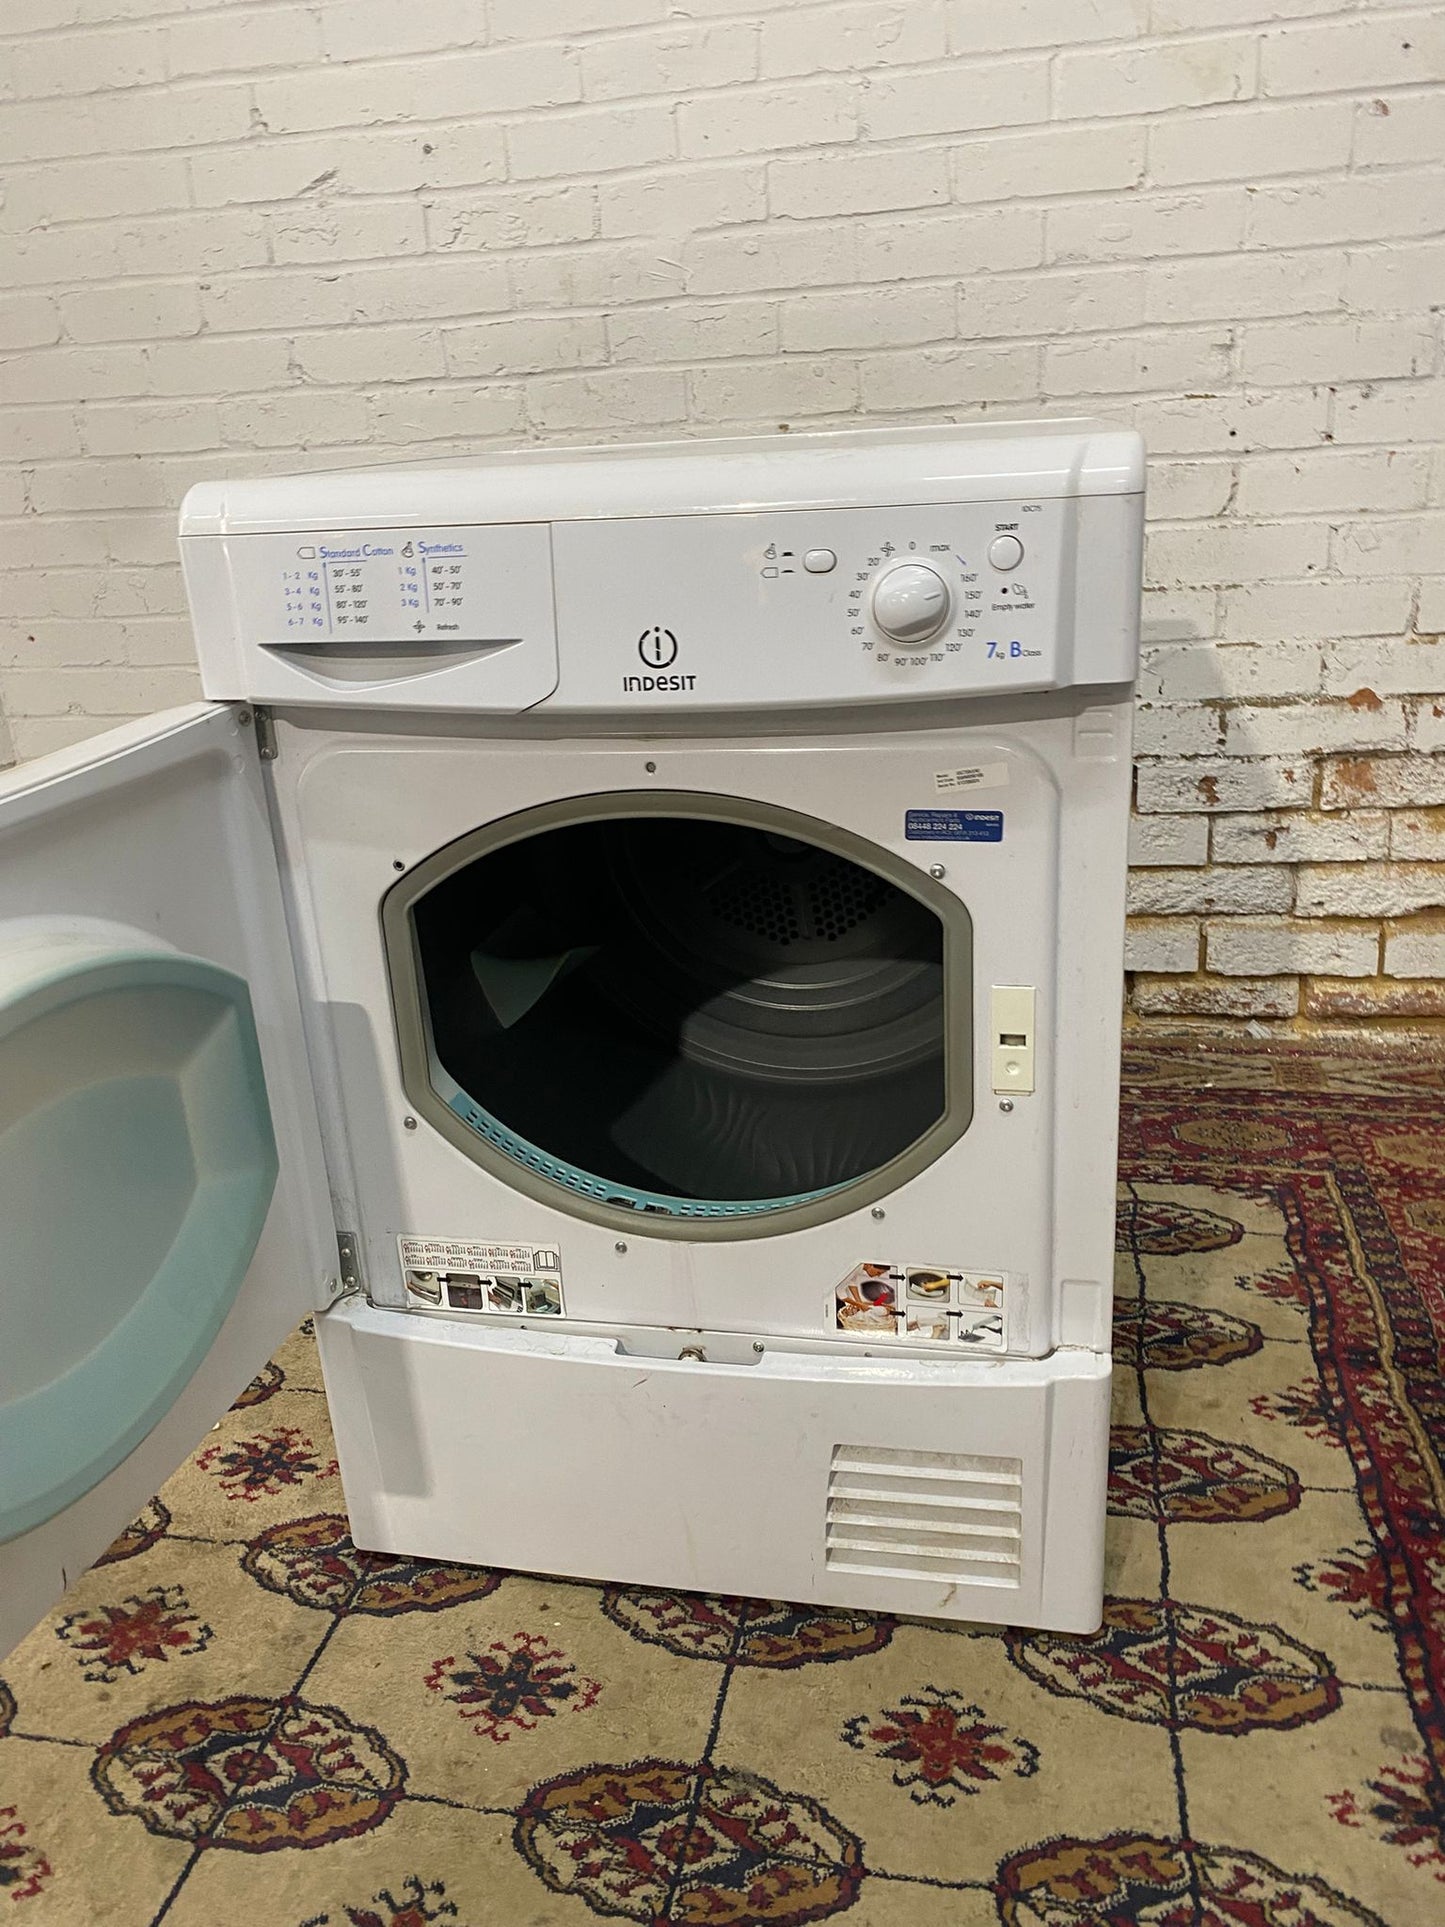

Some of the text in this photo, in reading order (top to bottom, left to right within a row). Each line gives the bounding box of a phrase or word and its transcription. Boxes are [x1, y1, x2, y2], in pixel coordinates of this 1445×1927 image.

[995, 523, 1019, 532] START
[417, 541, 464, 555] Synthetics
[909, 541, 917, 551] 0
[929, 544, 951, 552] max
[319, 544, 394, 559] Standard Cotton
[308, 571, 319, 581] Kg
[405, 566, 417, 577] Kg
[309, 586, 320, 596] Kg
[400, 583, 418, 593] 2 Kg
[311, 601, 322, 612] Kg
[401, 598, 420, 608] 3 Kg
[991, 602, 1035, 611] Empty water
[312, 616, 324, 627] Kg
[1010, 641, 1022, 658] B
[948, 823, 963, 831] 224
